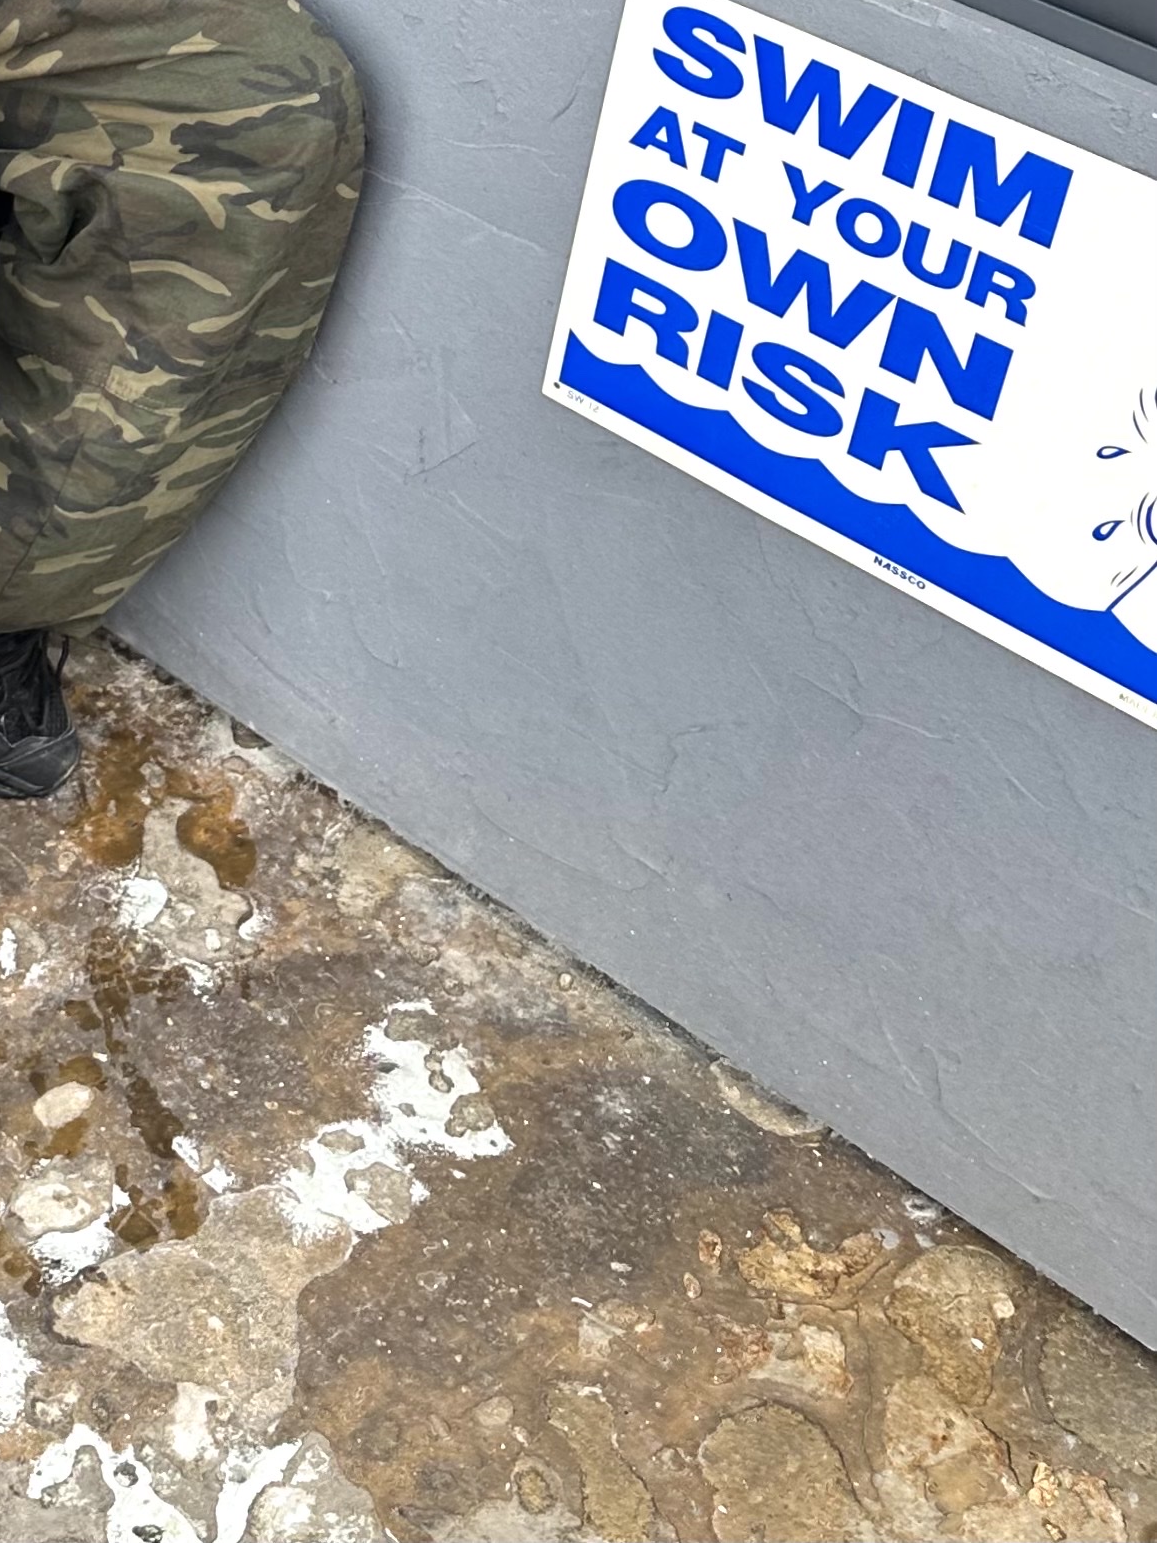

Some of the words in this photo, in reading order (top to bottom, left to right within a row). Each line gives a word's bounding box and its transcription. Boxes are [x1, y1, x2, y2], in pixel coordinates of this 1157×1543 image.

[630, 106, 746, 182] AT
[783, 162, 1037, 326] YOUR
[653, 6, 1073, 249] SWIM
[593, 258, 981, 514] RISK
[612, 179, 1013, 421] OWN
[874, 555, 926, 590] NASSCO
